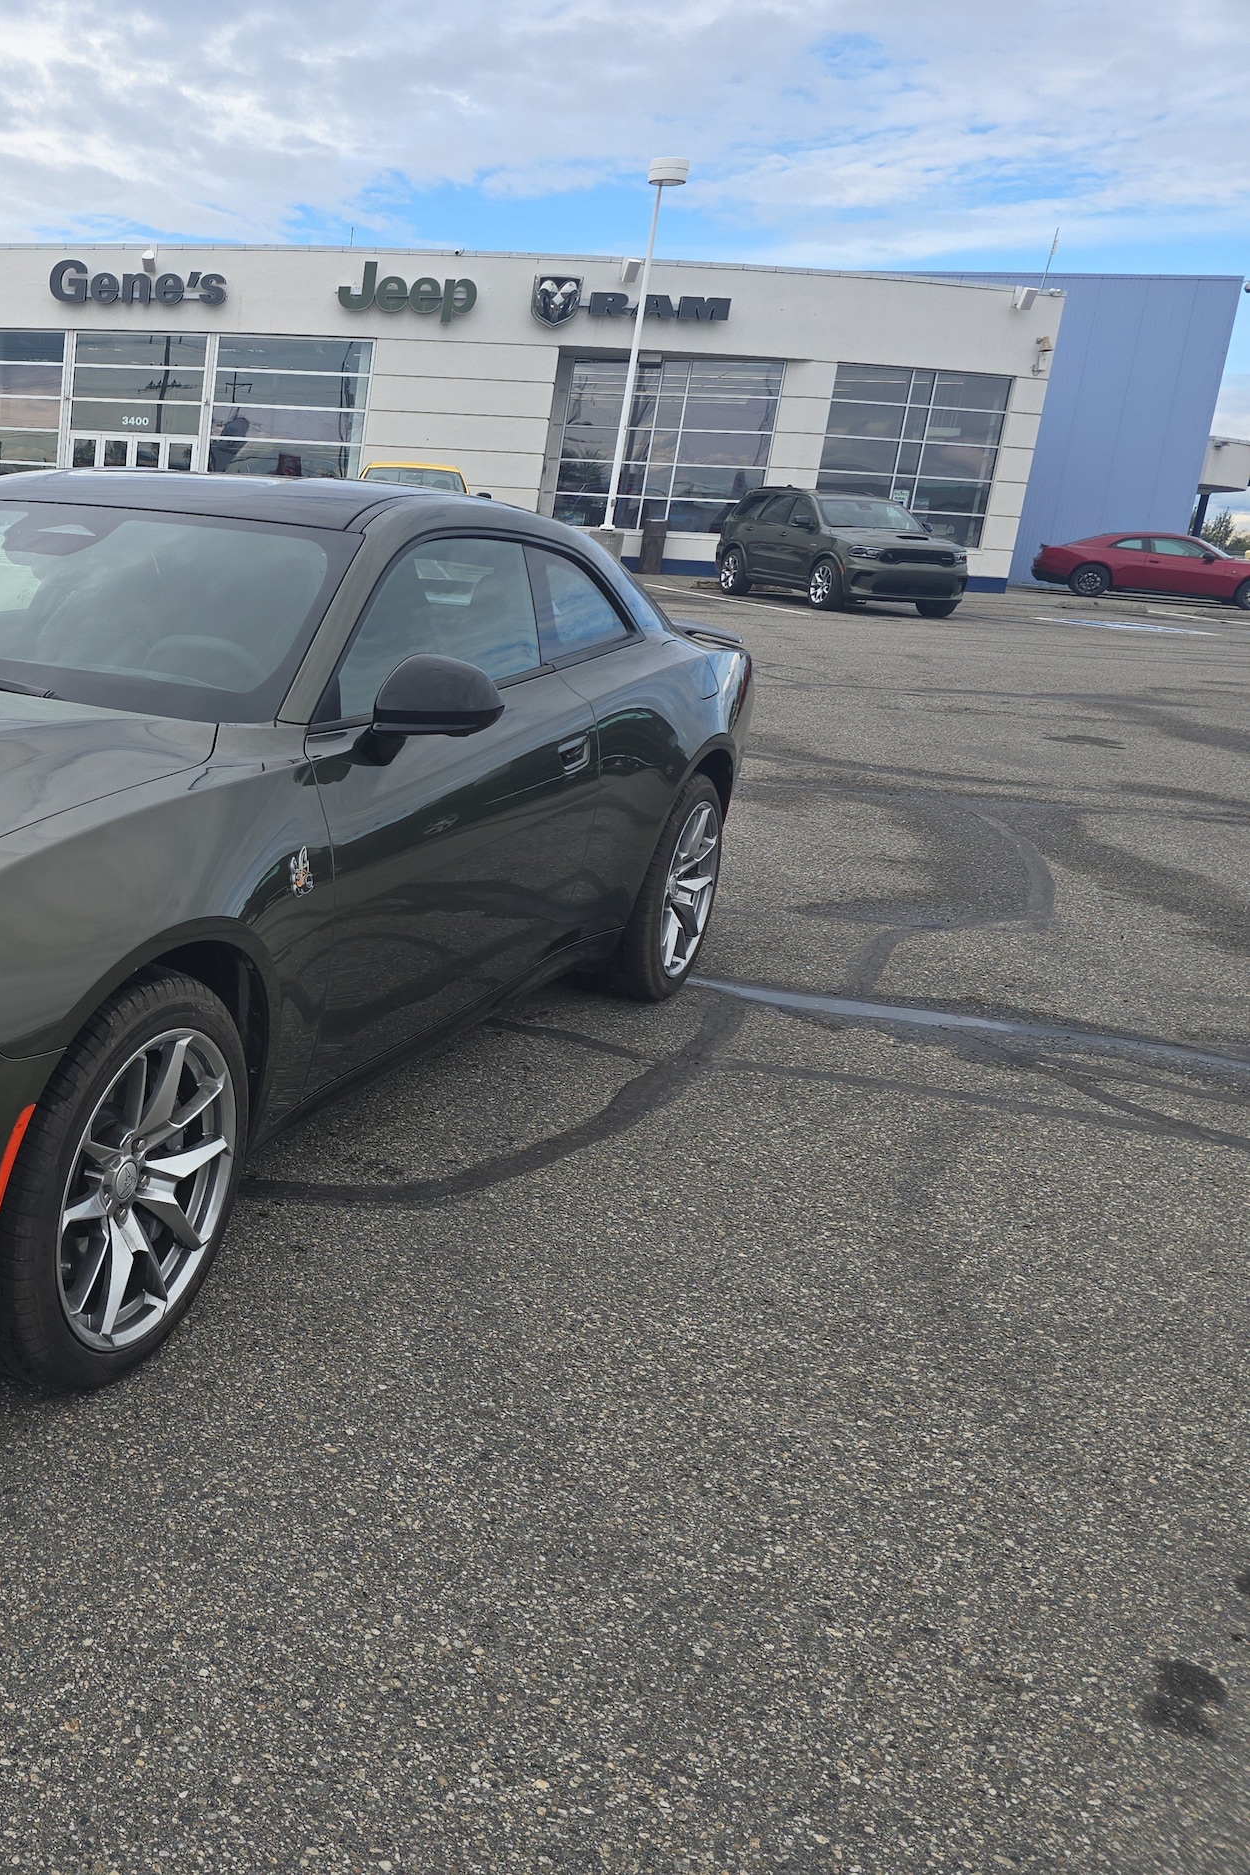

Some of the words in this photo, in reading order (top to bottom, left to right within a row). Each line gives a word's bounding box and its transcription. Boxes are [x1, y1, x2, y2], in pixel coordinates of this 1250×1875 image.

[49, 259, 228, 306] Gene's
[337, 261, 479, 323] Jeep
[589, 291, 732, 321] RAM
[122, 416, 149, 426] 3400
